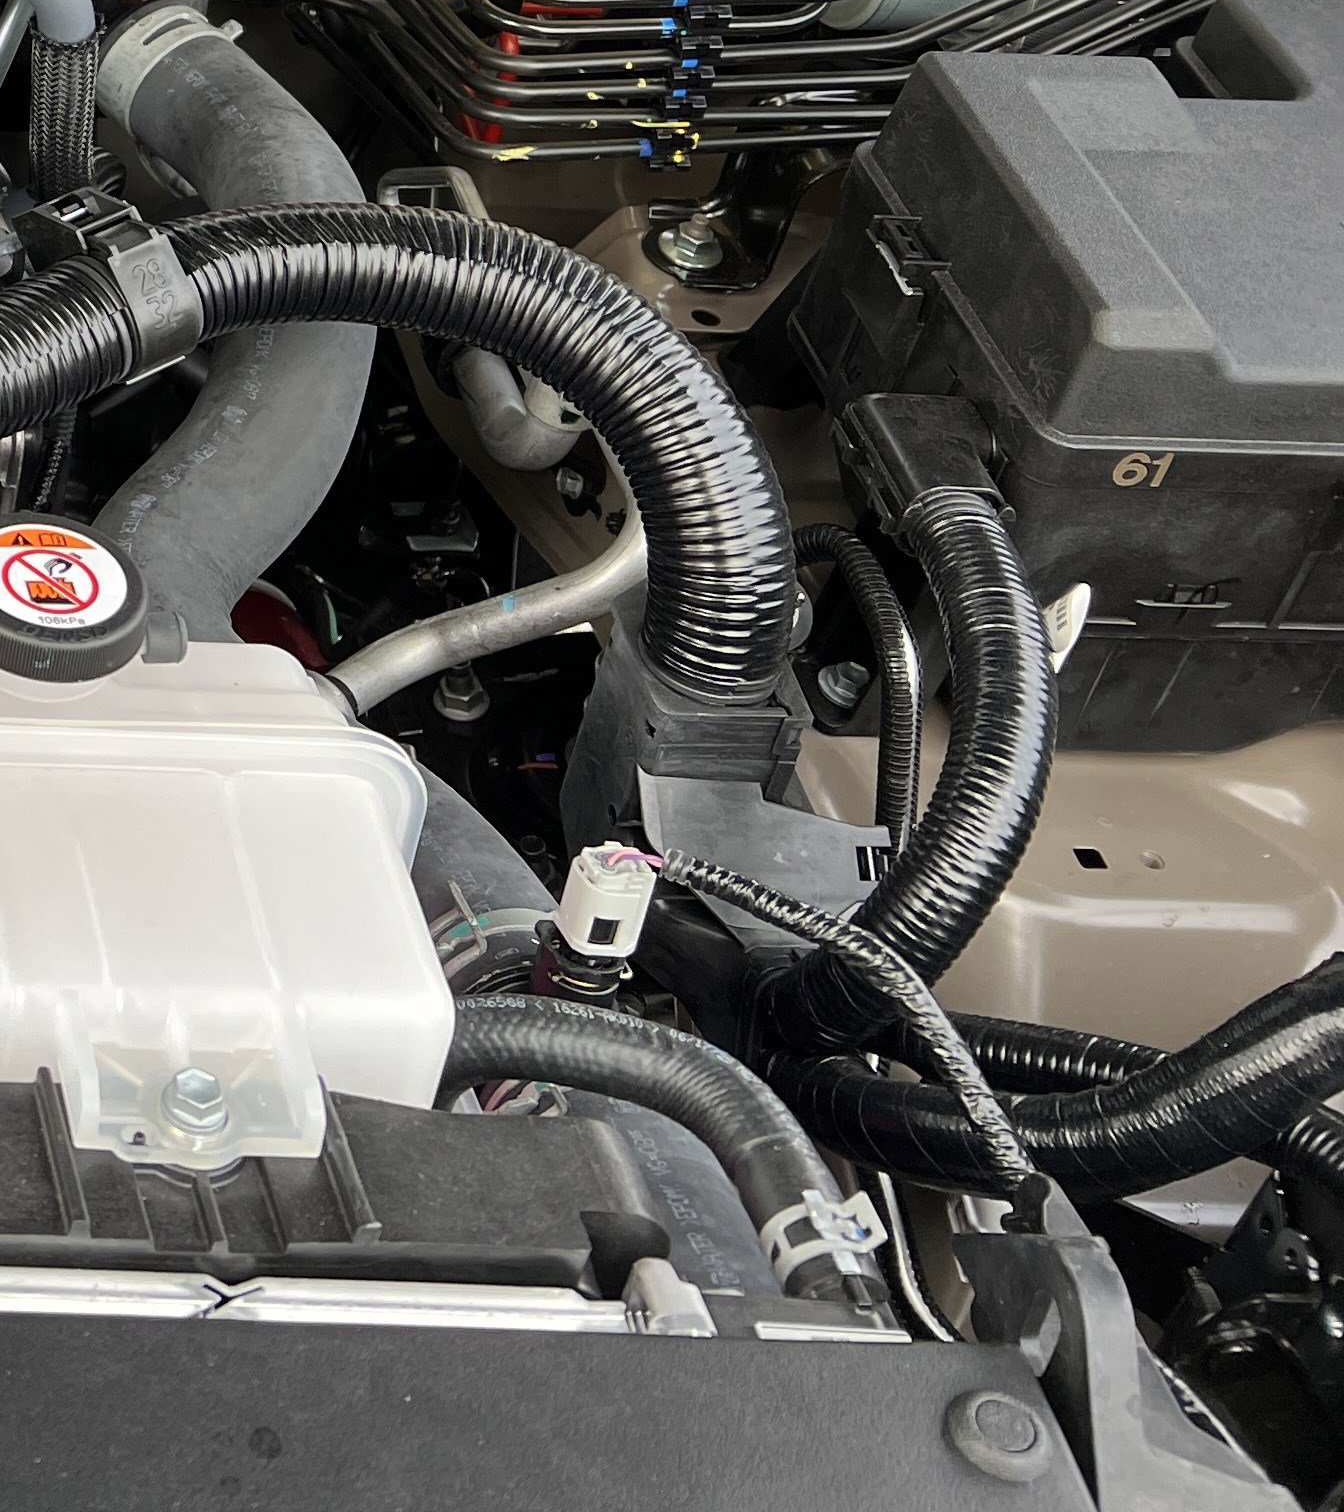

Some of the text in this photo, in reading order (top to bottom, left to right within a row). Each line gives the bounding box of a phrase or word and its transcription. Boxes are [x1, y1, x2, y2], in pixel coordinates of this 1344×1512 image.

[132, 258, 169, 296] 28
[146, 290, 184, 330] 32
[1111, 451, 1175, 487] 61
